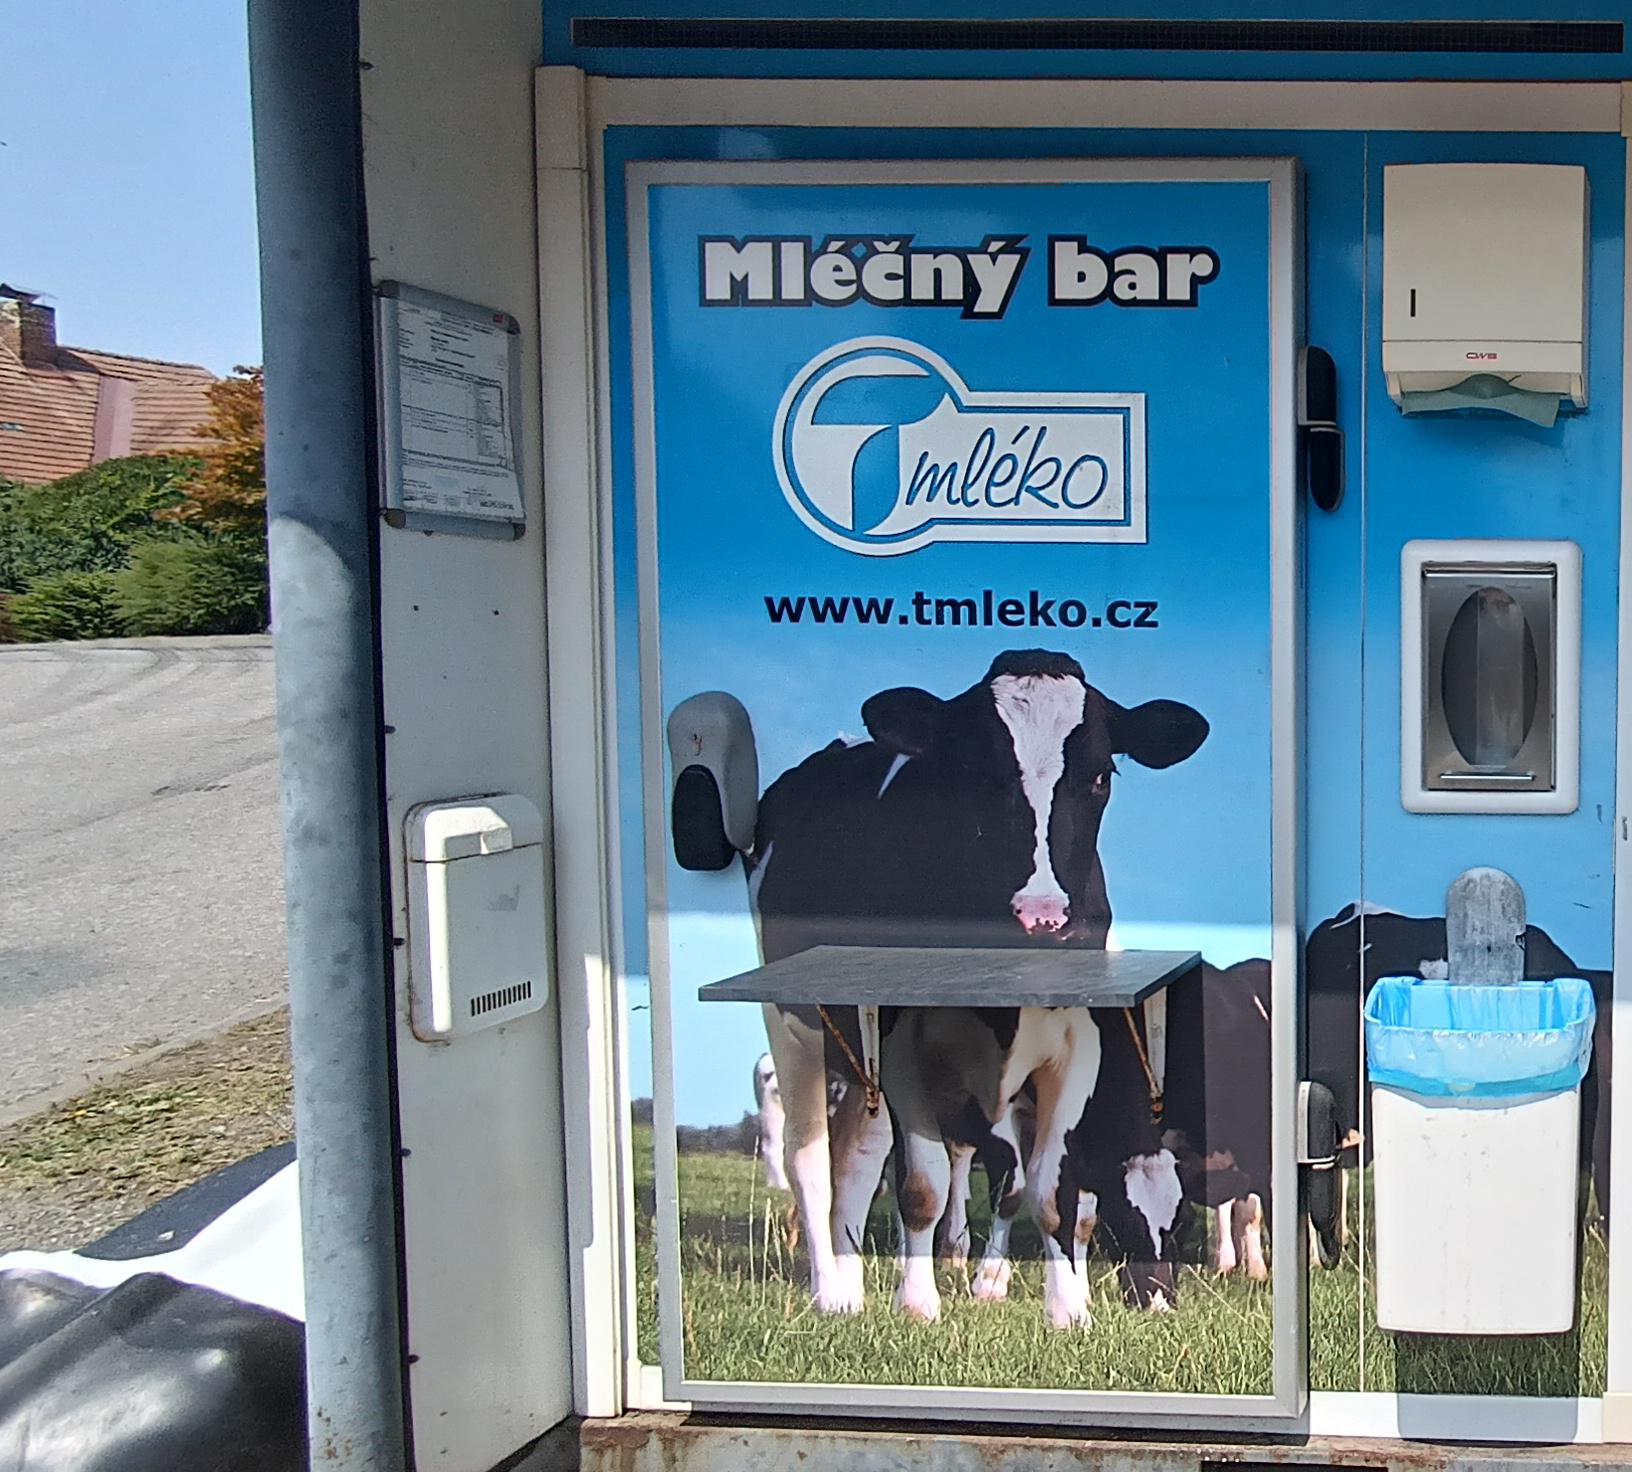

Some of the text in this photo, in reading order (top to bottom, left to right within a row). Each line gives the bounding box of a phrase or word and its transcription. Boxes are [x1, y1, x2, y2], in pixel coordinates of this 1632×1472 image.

[702, 236, 1219, 318] Mléčný bar
[764, 590, 1159, 629] www.tmleko.cz
